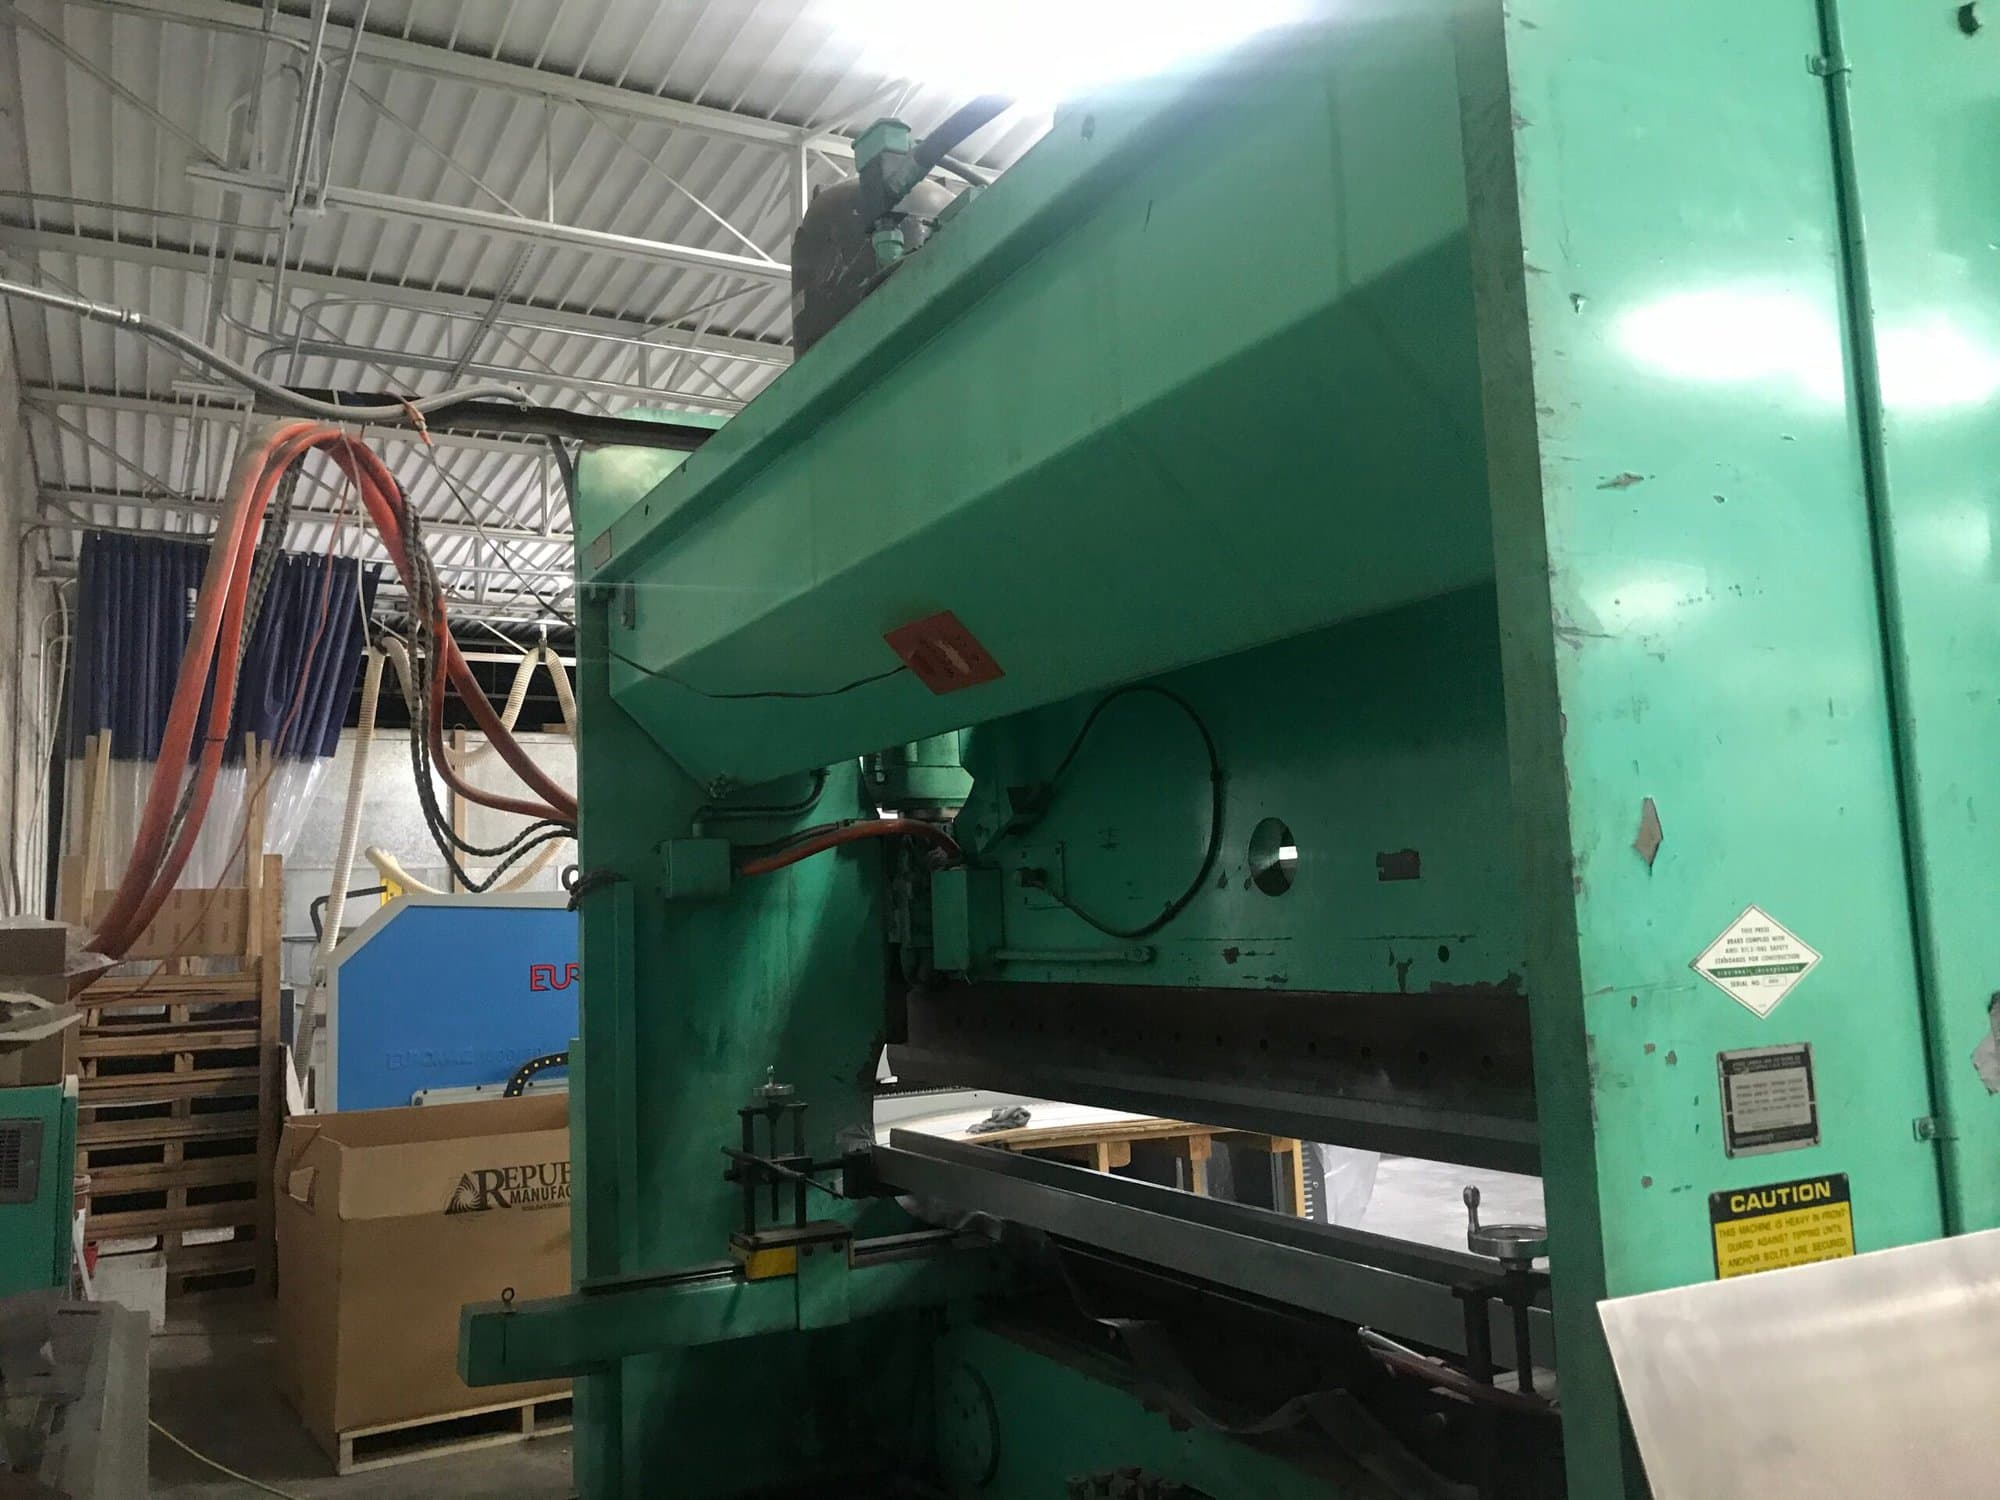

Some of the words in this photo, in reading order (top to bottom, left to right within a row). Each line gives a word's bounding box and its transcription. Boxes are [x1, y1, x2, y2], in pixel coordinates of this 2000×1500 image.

[1730, 1181, 1831, 1213] CAUTION
[1718, 1227, 1736, 1238] THIS
[1739, 1221, 1772, 1235] MACHINE
[1785, 1214, 1810, 1227] HEAVY
[1727, 1239, 1754, 1253] GUARD
[1758, 1233, 1788, 1247] AGAINST
[1728, 1254, 1760, 1268] ANCHOR
[1764, 1247, 1790, 1262] BOLTS
[1794, 1244, 1808, 1255] ARE
